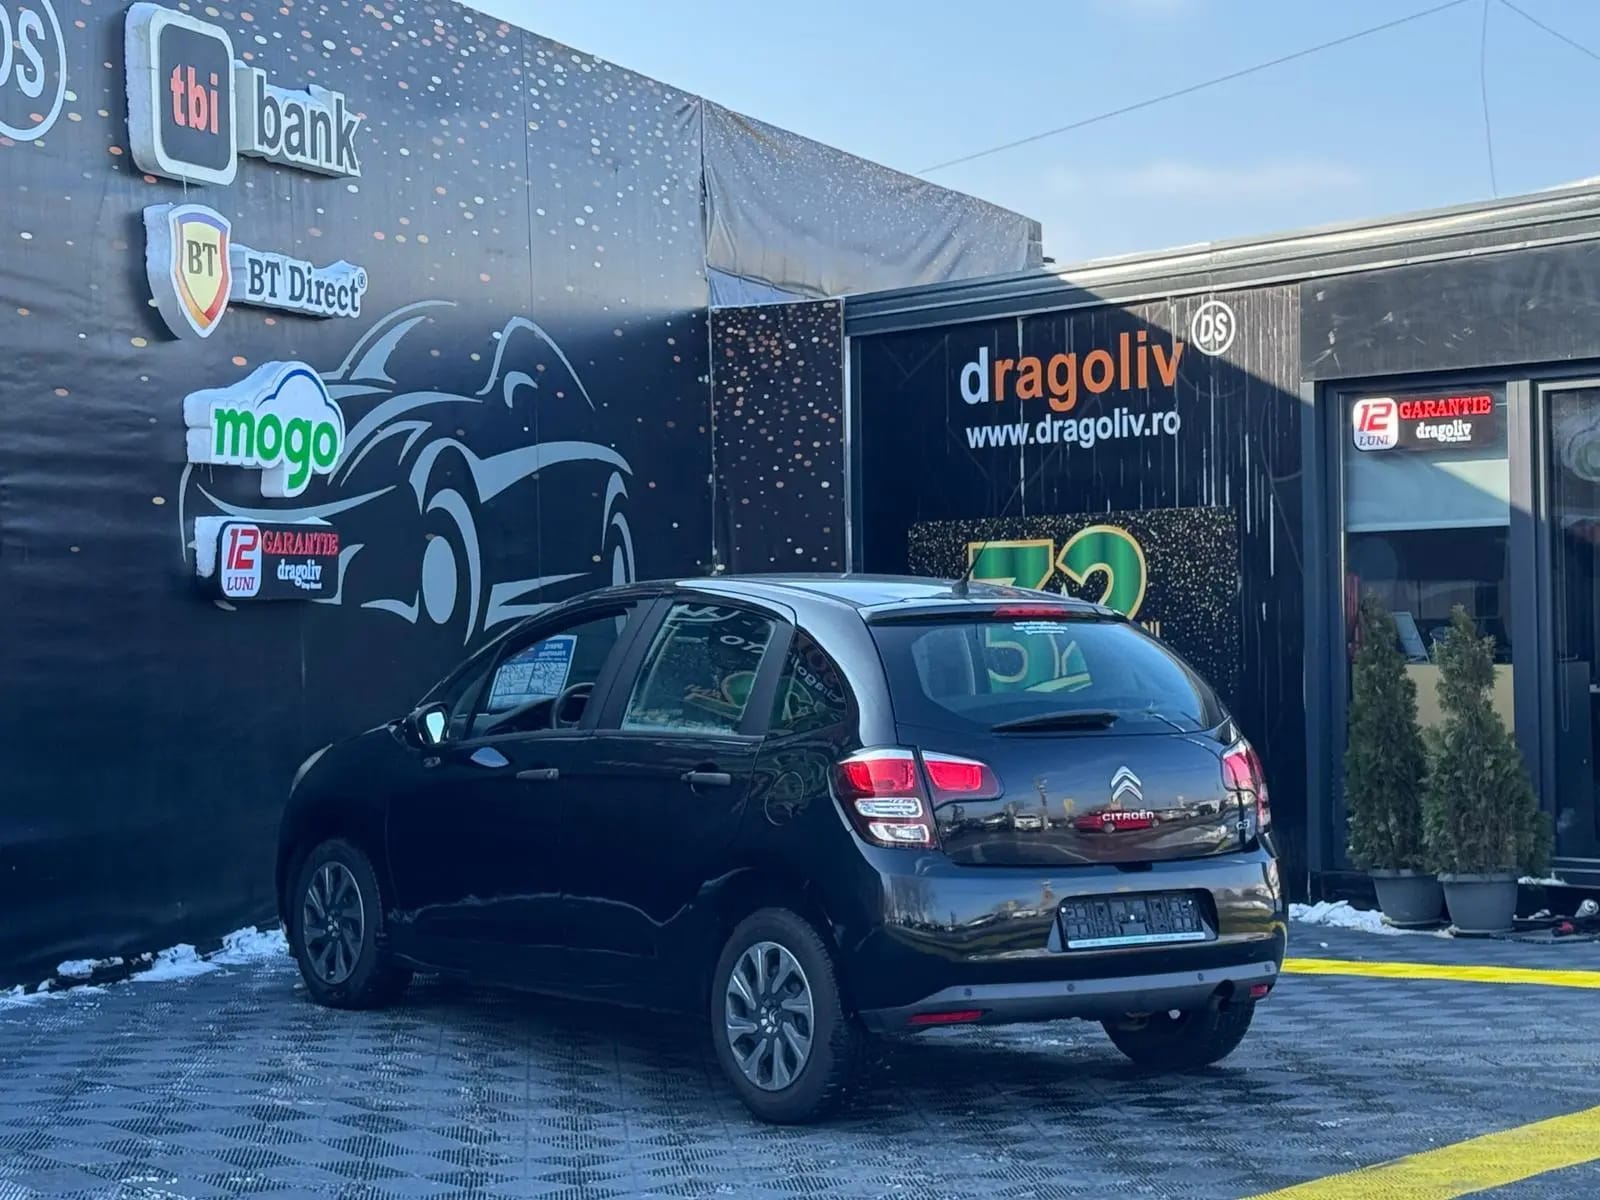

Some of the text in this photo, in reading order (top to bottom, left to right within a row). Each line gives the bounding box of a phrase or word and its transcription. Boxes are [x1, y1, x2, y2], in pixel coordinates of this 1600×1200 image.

[170, 64, 359, 172] tbi bank
[186, 239, 218, 278] BT
[247, 257, 281, 296] BT
[1200, 312, 1228, 343] DS
[960, 331, 1184, 412] dragoliv
[966, 407, 1181, 449] www.dragoliv.ro
[1358, 396, 1491, 432] 12 GARANTIE
[1415, 419, 1472, 442] dragoliv
[214, 408, 338, 490] mogo
[1359, 434, 1389, 446] LUNI
[226, 528, 339, 570] 12 GARANTIE
[227, 576, 256, 591] LUNI
[277, 558, 322, 587] dragoliv
